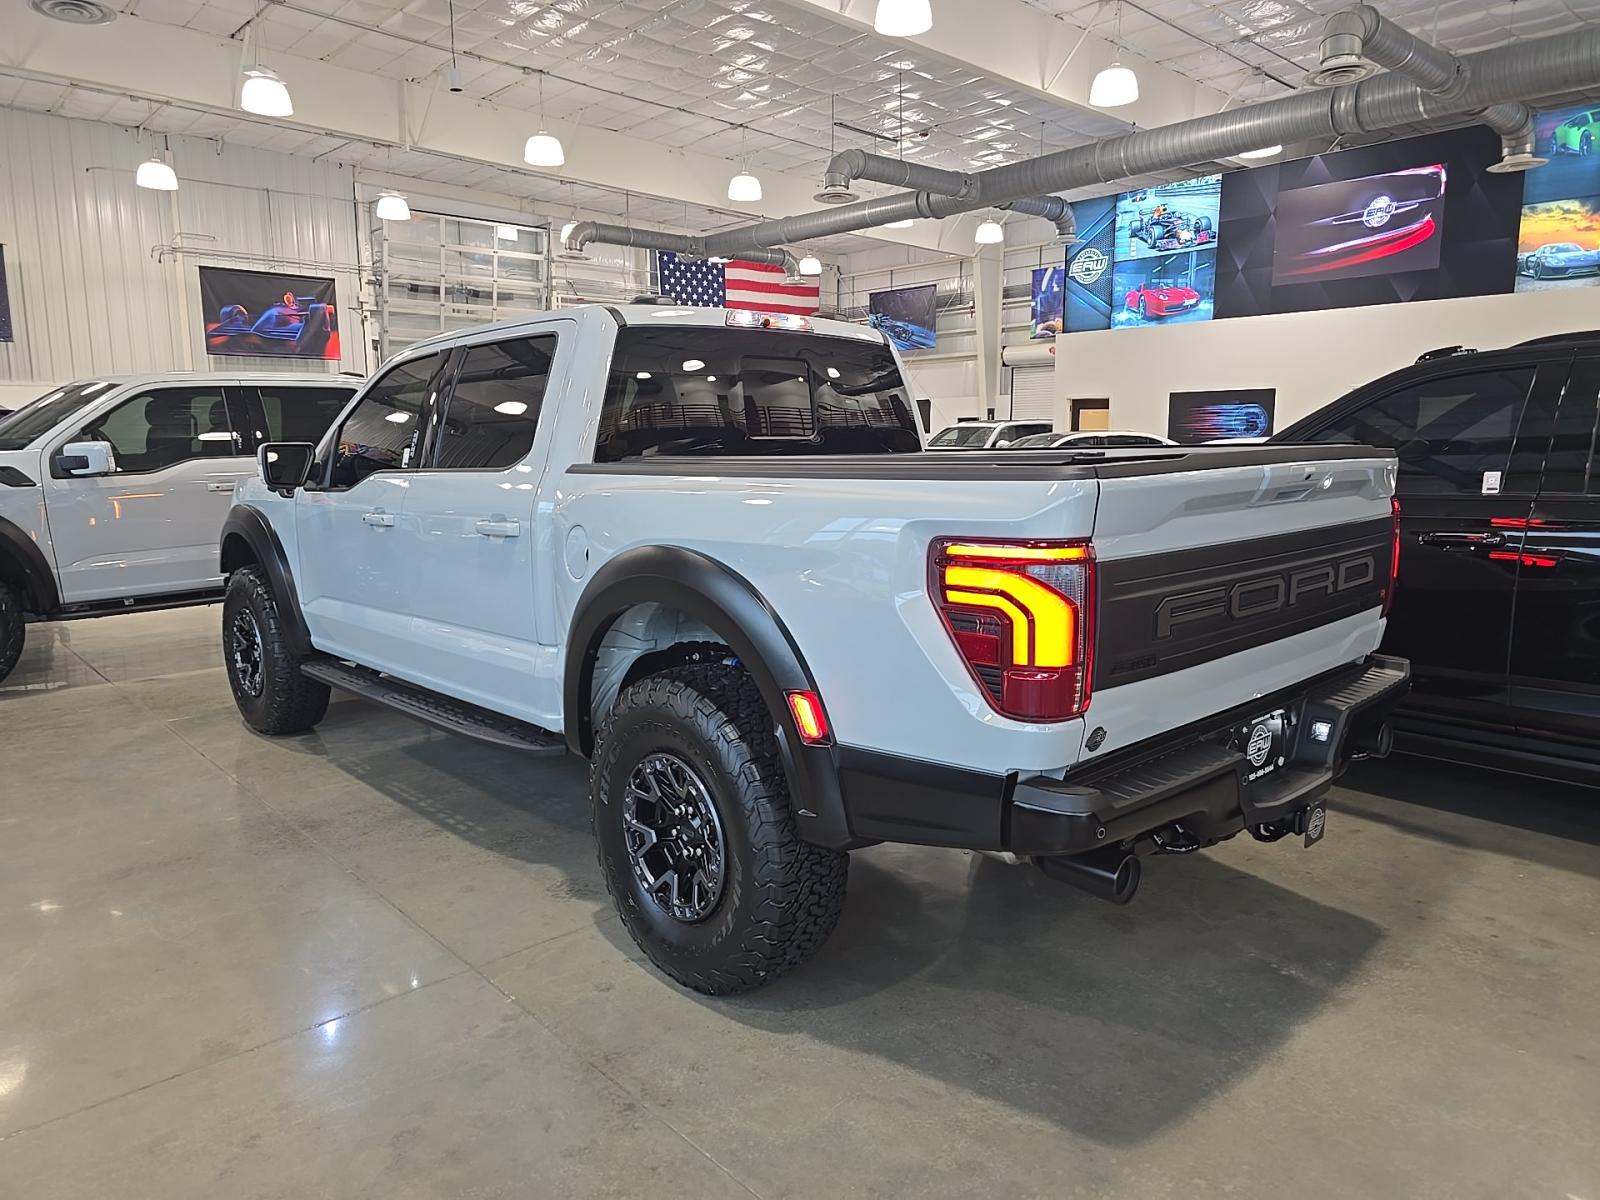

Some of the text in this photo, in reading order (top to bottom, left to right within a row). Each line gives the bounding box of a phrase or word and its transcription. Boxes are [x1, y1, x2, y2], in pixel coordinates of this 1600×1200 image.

[1072, 257, 1106, 273] EAW
[1153, 554, 1376, 641] FORD
[1249, 734, 1271, 755] EAW
